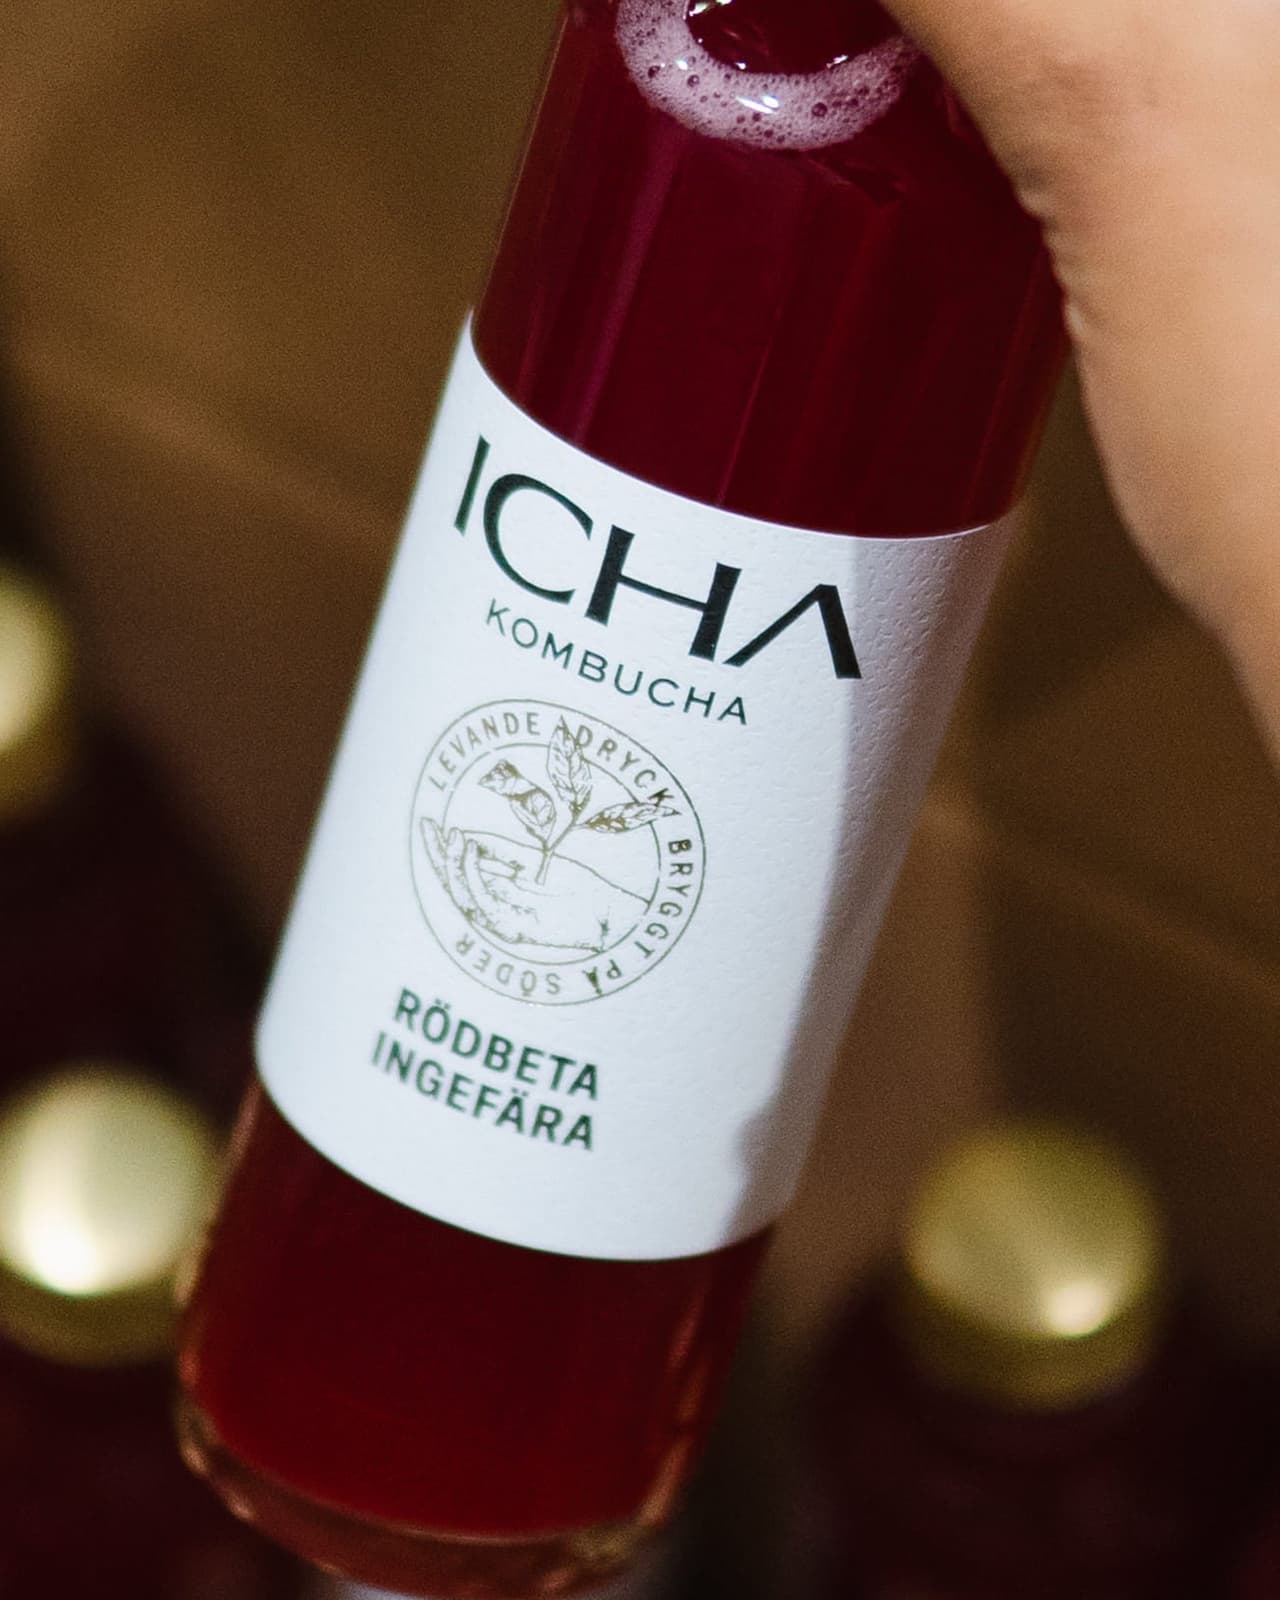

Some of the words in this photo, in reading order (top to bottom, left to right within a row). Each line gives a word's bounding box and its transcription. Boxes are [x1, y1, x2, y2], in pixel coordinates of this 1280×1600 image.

[454, 435, 862, 679] ICHA
[486, 598, 747, 725] KOMBUCHA
[429, 712, 540, 791] LEVANDE
[575, 725, 674, 806] DRYCK
[634, 839, 694, 959] BRYGGT
[456, 934, 561, 995] SÖDER
[371, 1031, 593, 1151] INGEFÄRA
[394, 987, 598, 1101] RÖDBETA
